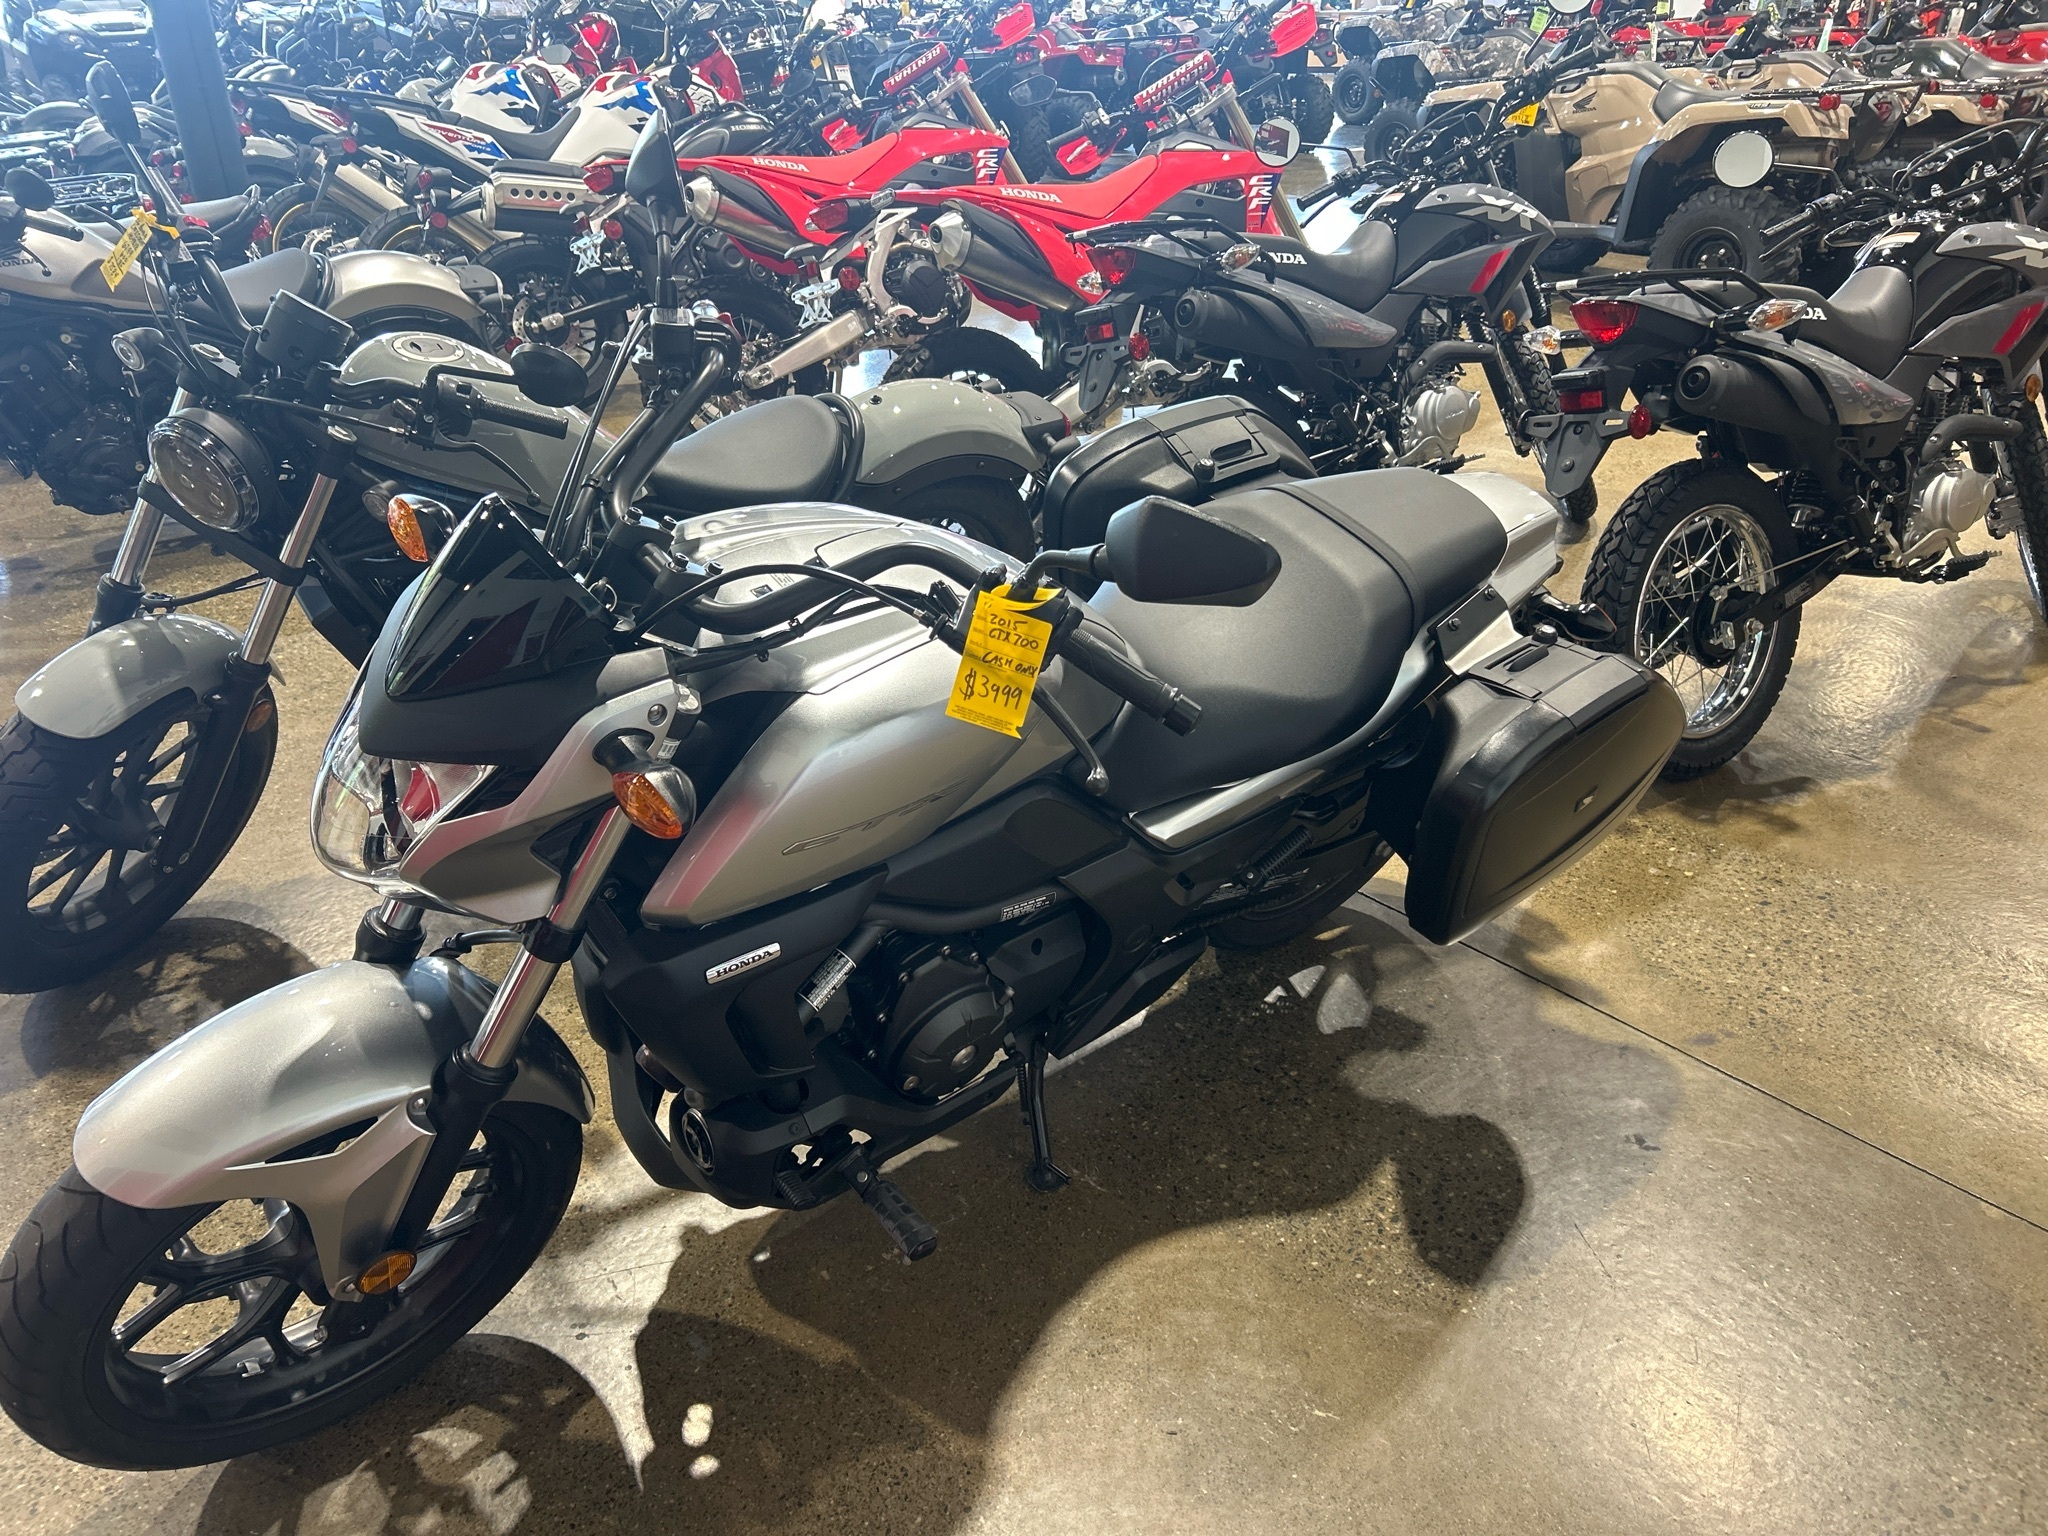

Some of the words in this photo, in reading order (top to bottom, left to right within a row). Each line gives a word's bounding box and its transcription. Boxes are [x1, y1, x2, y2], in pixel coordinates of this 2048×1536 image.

[887, 46, 941, 86] RENTHAL
[1142, 62, 1208, 107] RENTHAL
[730, 123, 767, 132] HONDA
[751, 157, 810, 172] HONDA
[976, 148, 999, 179] CRF
[999, 187, 1063, 204] HONDA
[1248, 175, 1274, 210] CRF
[1265, 252, 1307, 265] NDA
[989, 613, 1028, 631] 2015
[982, 651, 1014, 668] CASH
[958, 667, 1023, 711] $3999
[716, 950, 774, 978] HONDA
